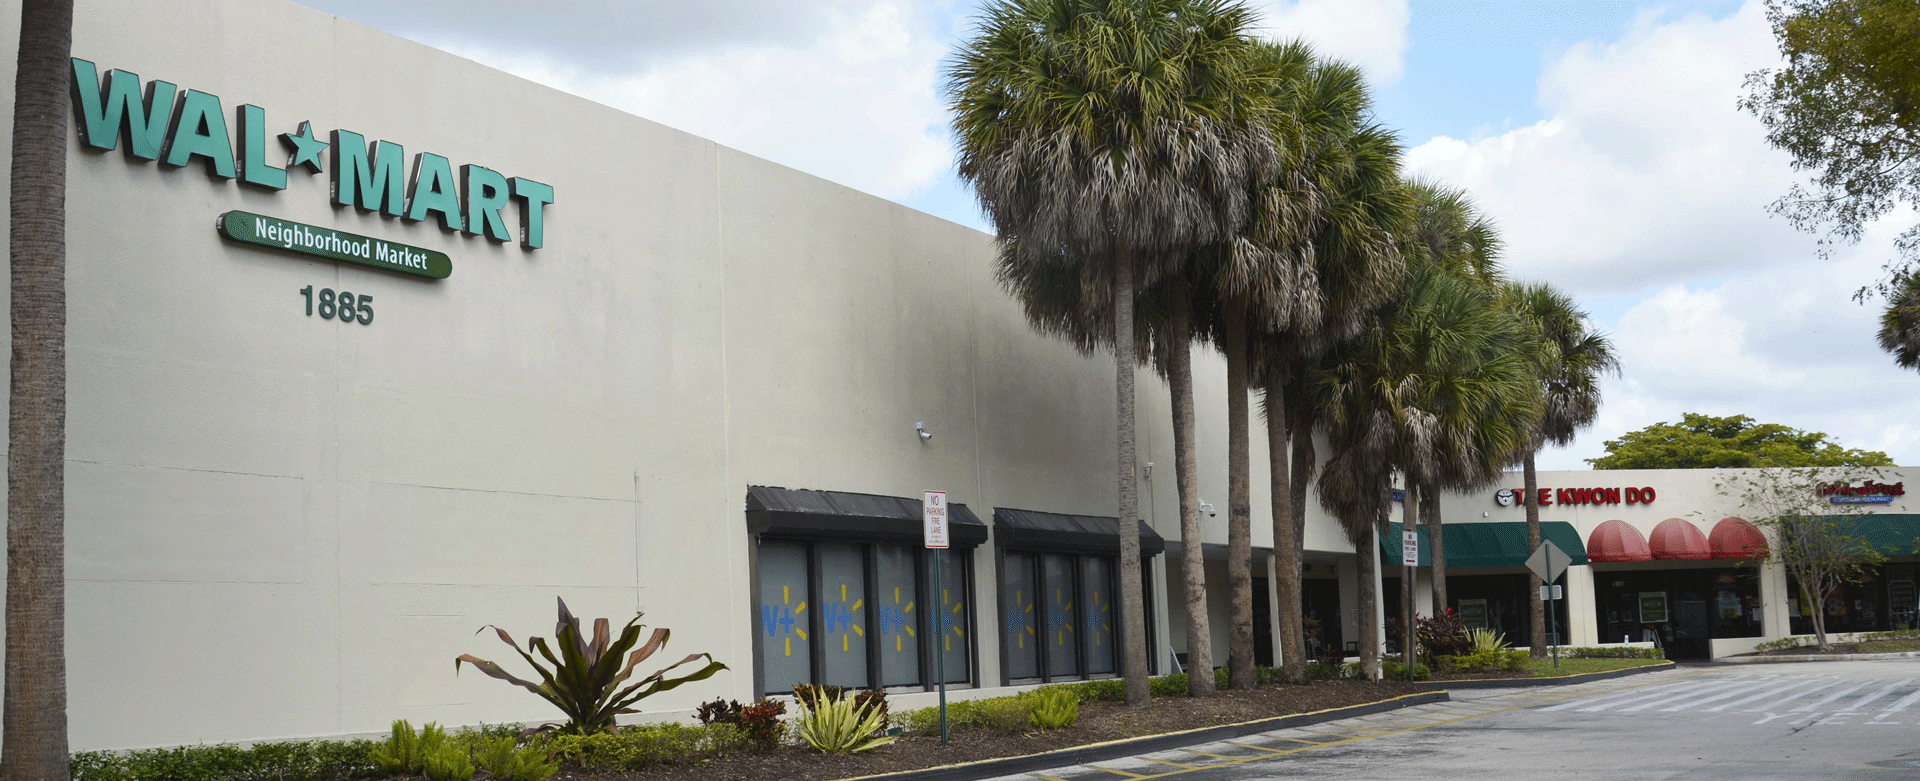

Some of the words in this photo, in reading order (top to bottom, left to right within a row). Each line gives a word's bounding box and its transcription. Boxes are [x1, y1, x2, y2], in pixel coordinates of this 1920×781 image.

[255, 217, 371, 259] Neighborhood
[375, 243, 428, 270] Market
[300, 284, 374, 325] 1885
[930, 495, 940, 506] NO
[1513, 487, 1553, 507] TE
[1557, 486, 1621, 506] KWON
[1626, 486, 1656, 506] DO
[926, 507, 945, 516] PARKING
[931, 517, 940, 525] FIRE
[930, 526, 942, 534] LANE
[1751, 712, 1920, 725] YIEL
